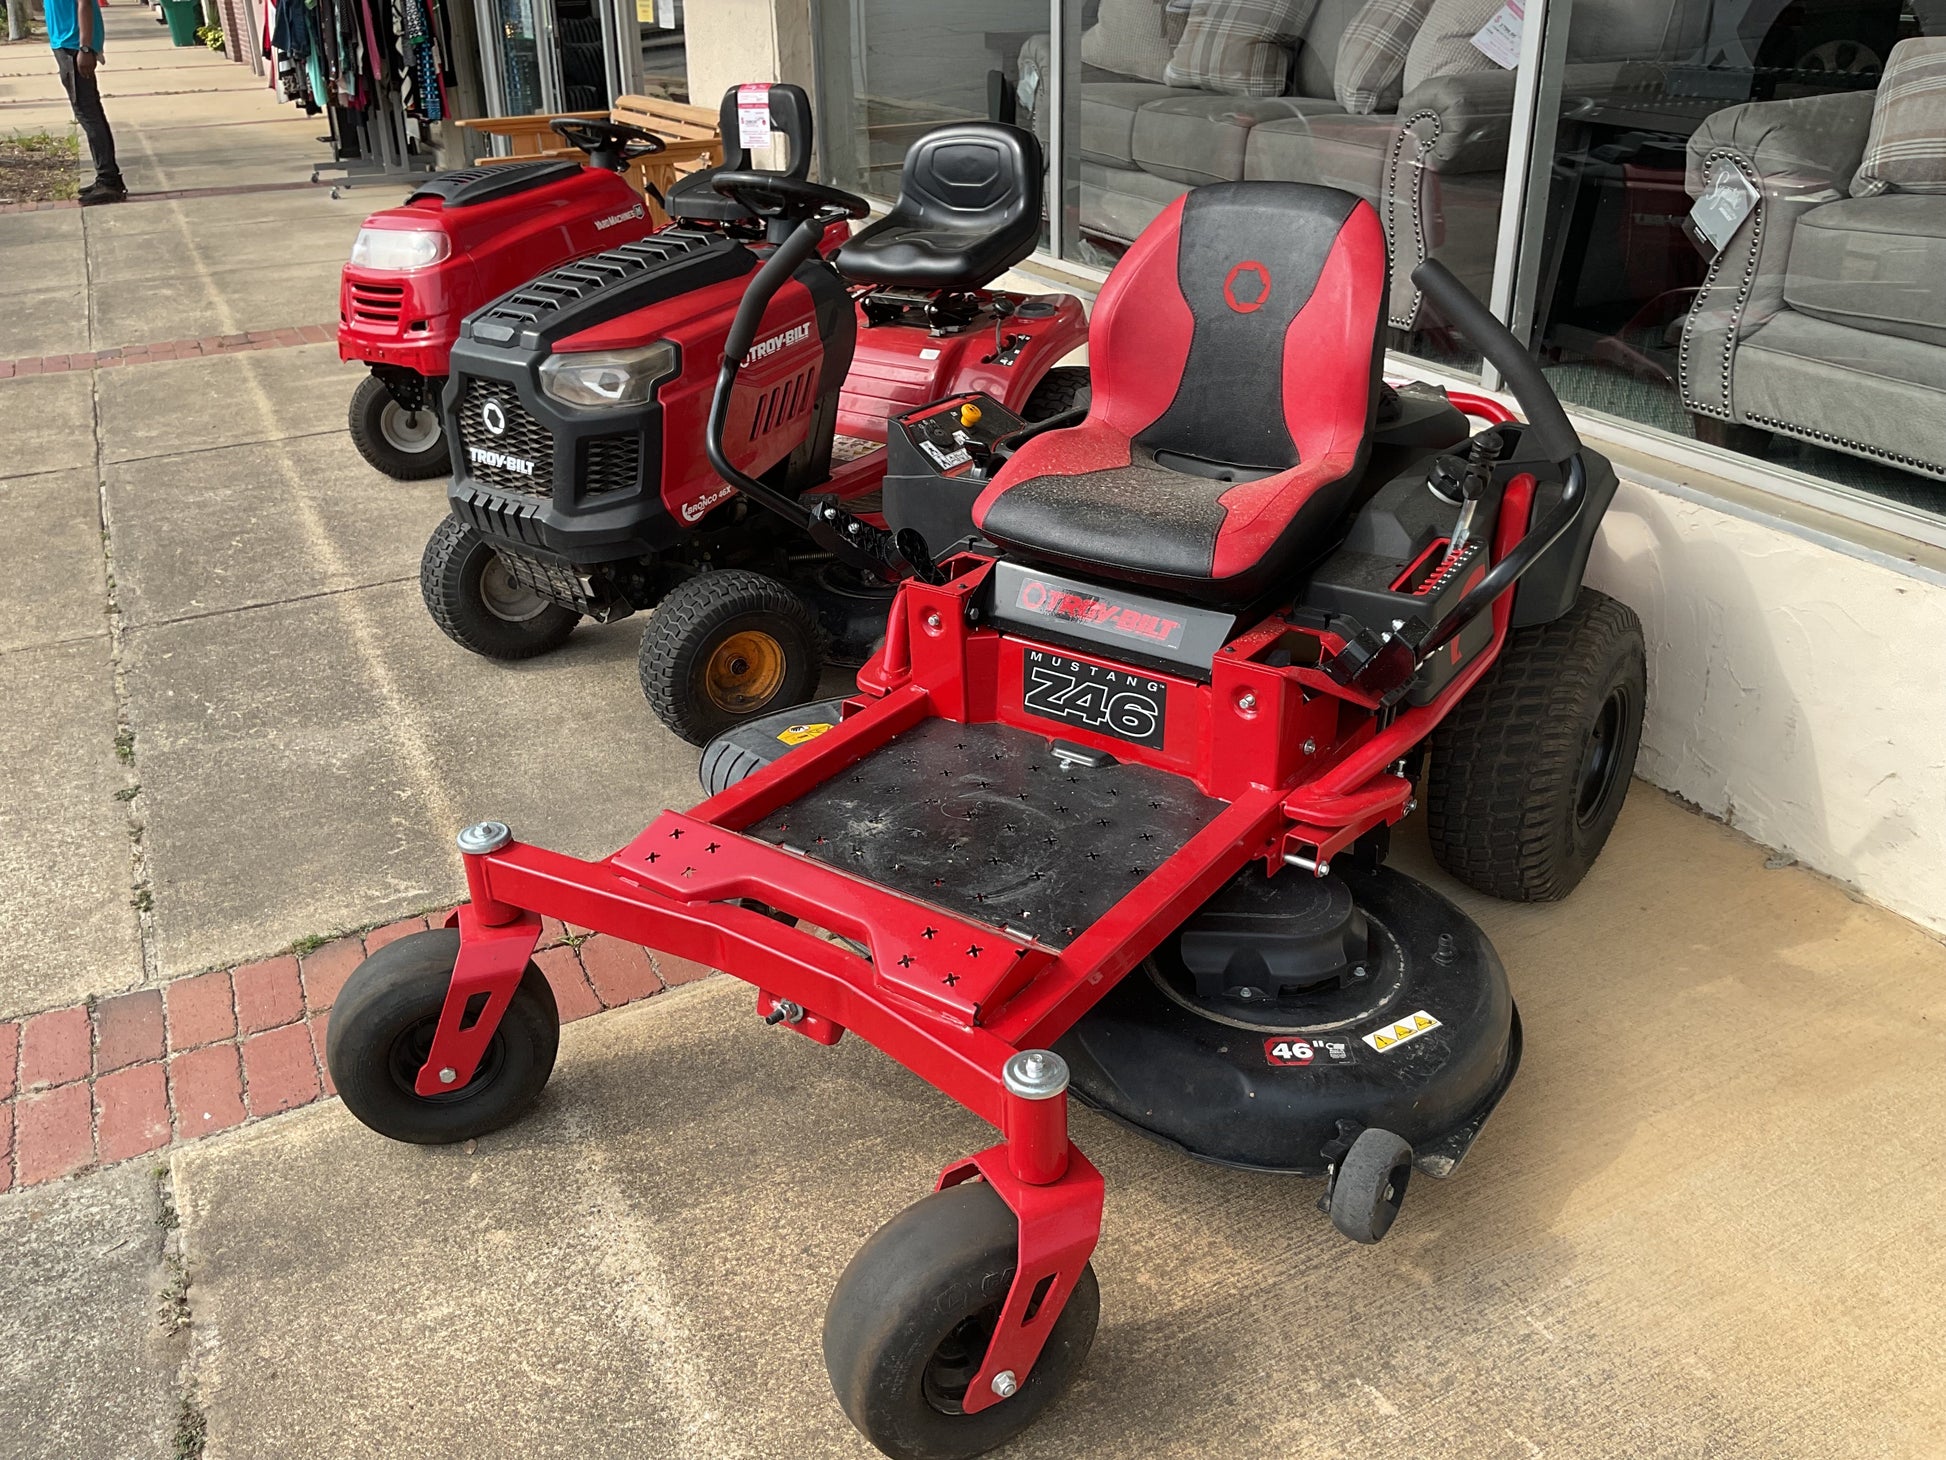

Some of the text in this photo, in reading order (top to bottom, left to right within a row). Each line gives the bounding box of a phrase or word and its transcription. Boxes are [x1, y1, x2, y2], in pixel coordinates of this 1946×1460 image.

[594, 219, 611, 230] YARD
[608, 210, 636, 226] MACHINES
[749, 321, 811, 363] TROY-BILT
[469, 447, 534, 475] TROY-BILT
[687, 493, 718, 515] BRONCO
[1046, 590, 1180, 641] TROY-BILT
[1024, 666, 1159, 738] Z46
[1272, 1040, 1325, 1059] 46"
